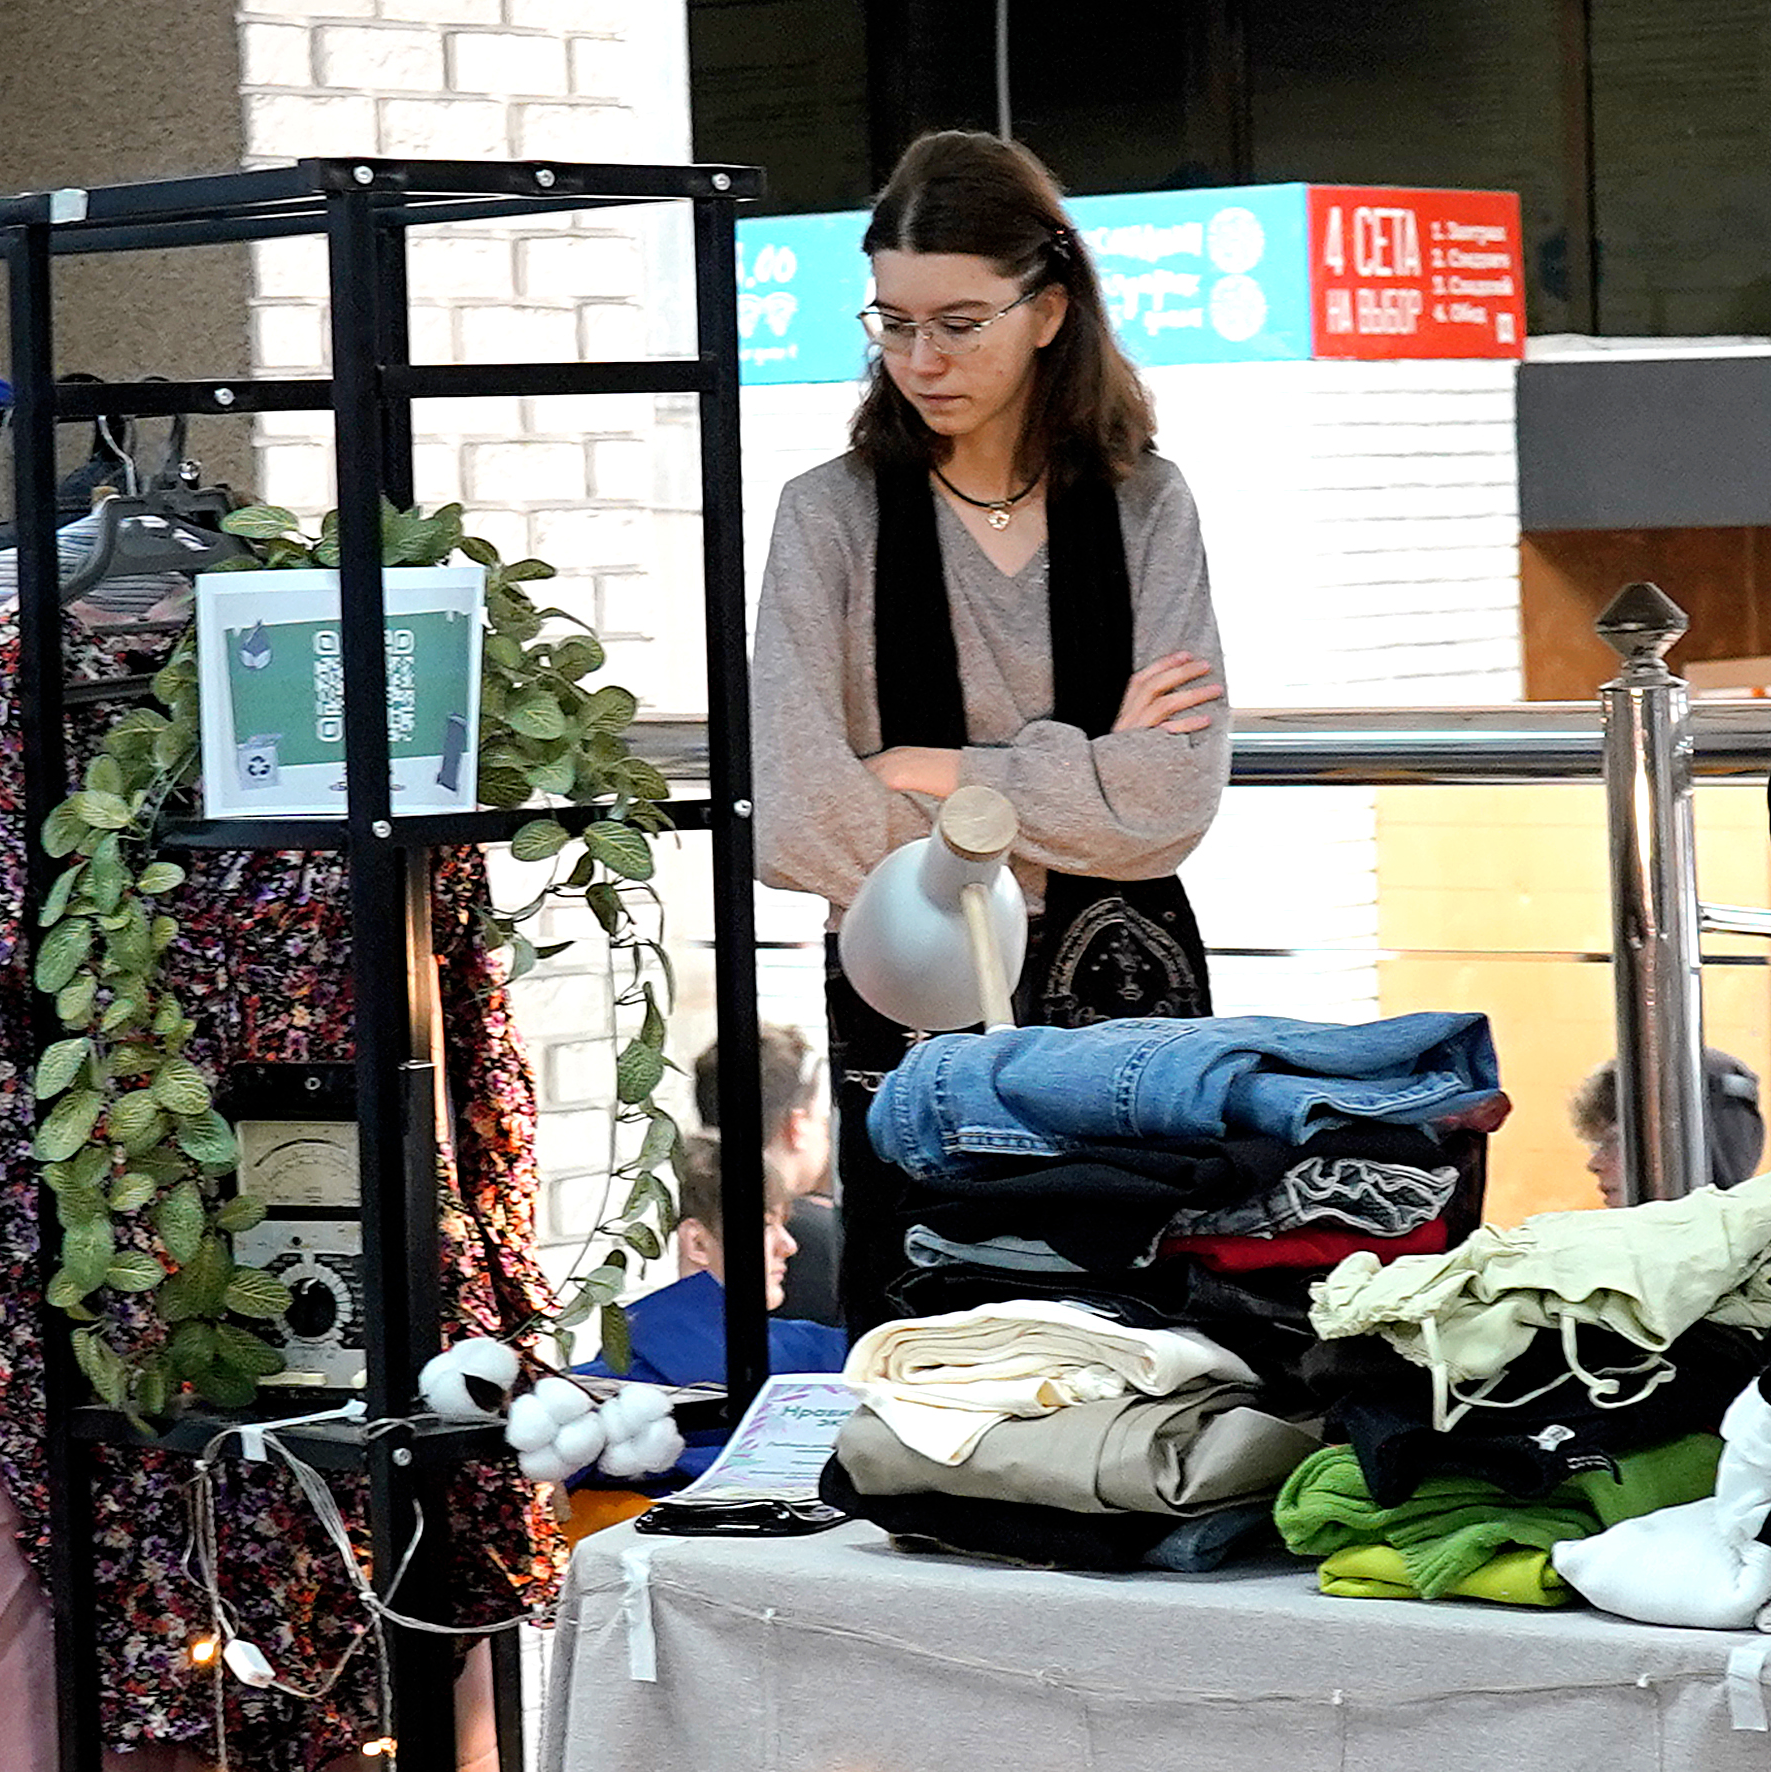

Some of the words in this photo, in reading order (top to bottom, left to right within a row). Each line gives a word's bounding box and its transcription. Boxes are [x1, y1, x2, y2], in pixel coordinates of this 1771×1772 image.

[1324, 206, 1345, 277] 4
[1353, 206, 1423, 277] СЕТА
[1326, 288, 1354, 335] НА
[1356, 288, 1424, 335] ВЫБОР
